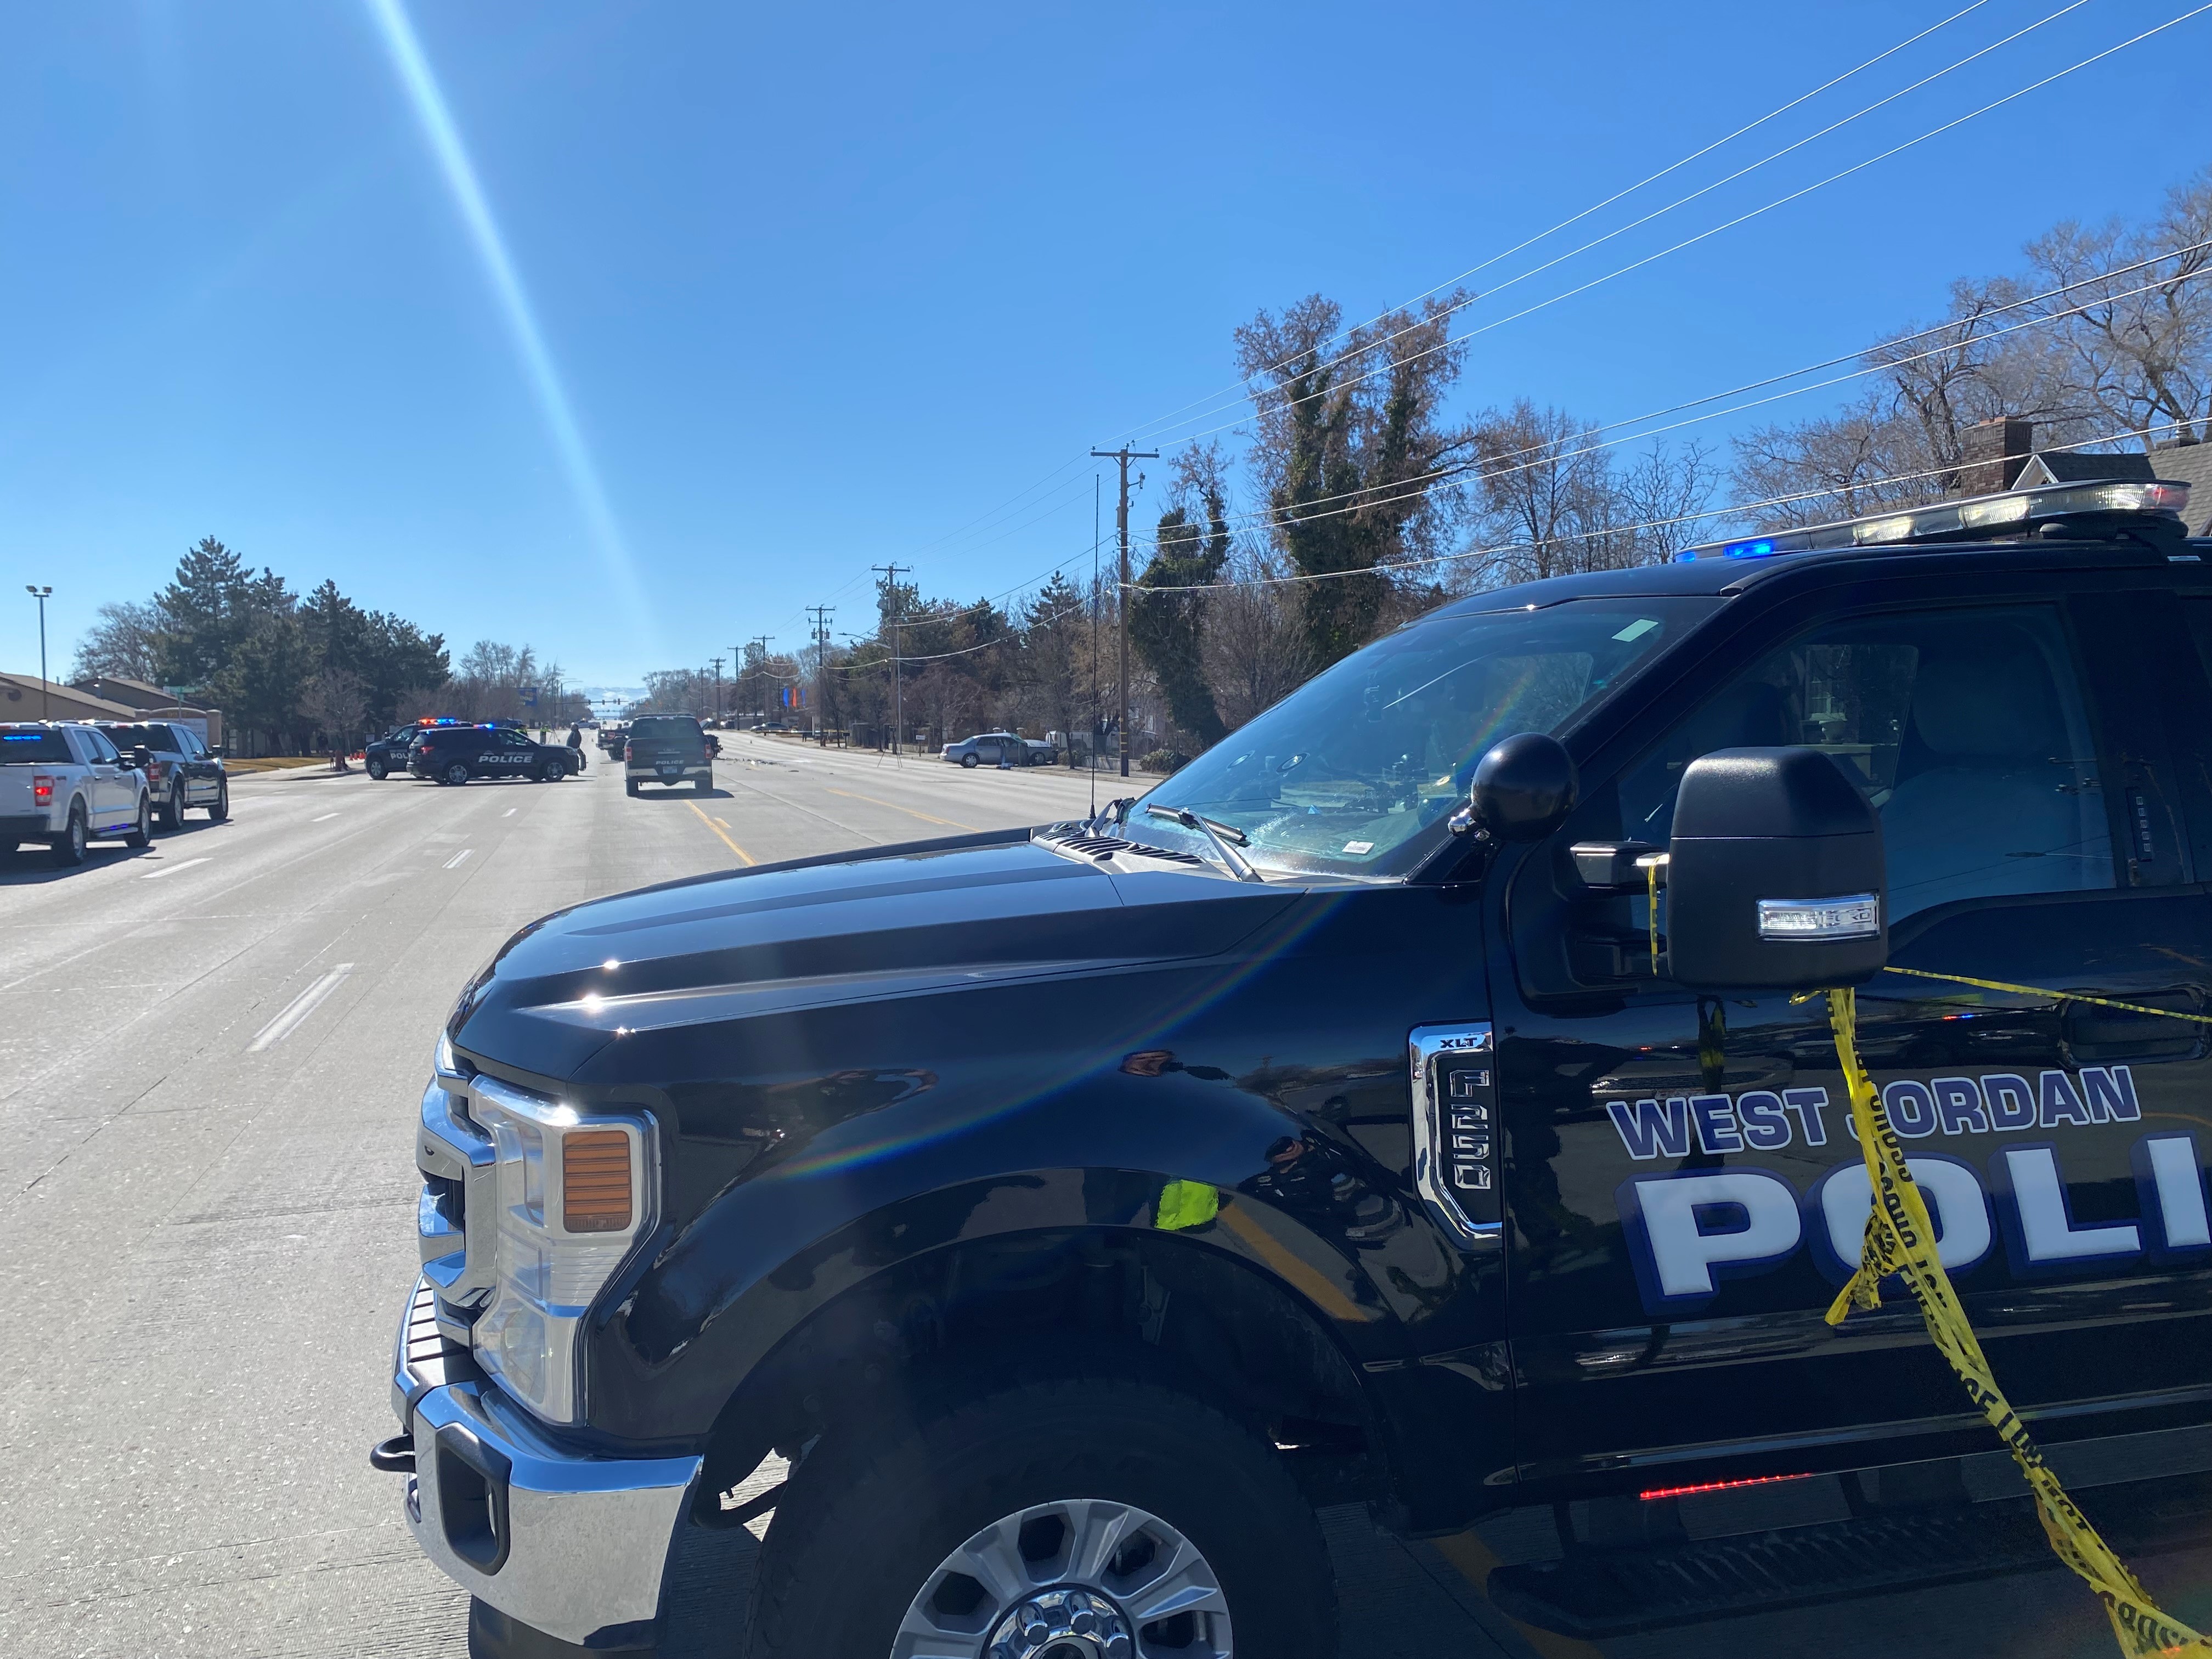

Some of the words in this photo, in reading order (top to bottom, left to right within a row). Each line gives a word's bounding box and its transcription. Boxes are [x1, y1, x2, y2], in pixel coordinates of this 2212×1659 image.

[1440, 1037, 1477, 1048] XLT
[1449, 1069, 1491, 1190] F250
[1606, 1086, 1828, 1160] WEST
[1846, 1064, 2141, 1139] ORDAN
[1624, 1133, 2212, 1301] POLI
